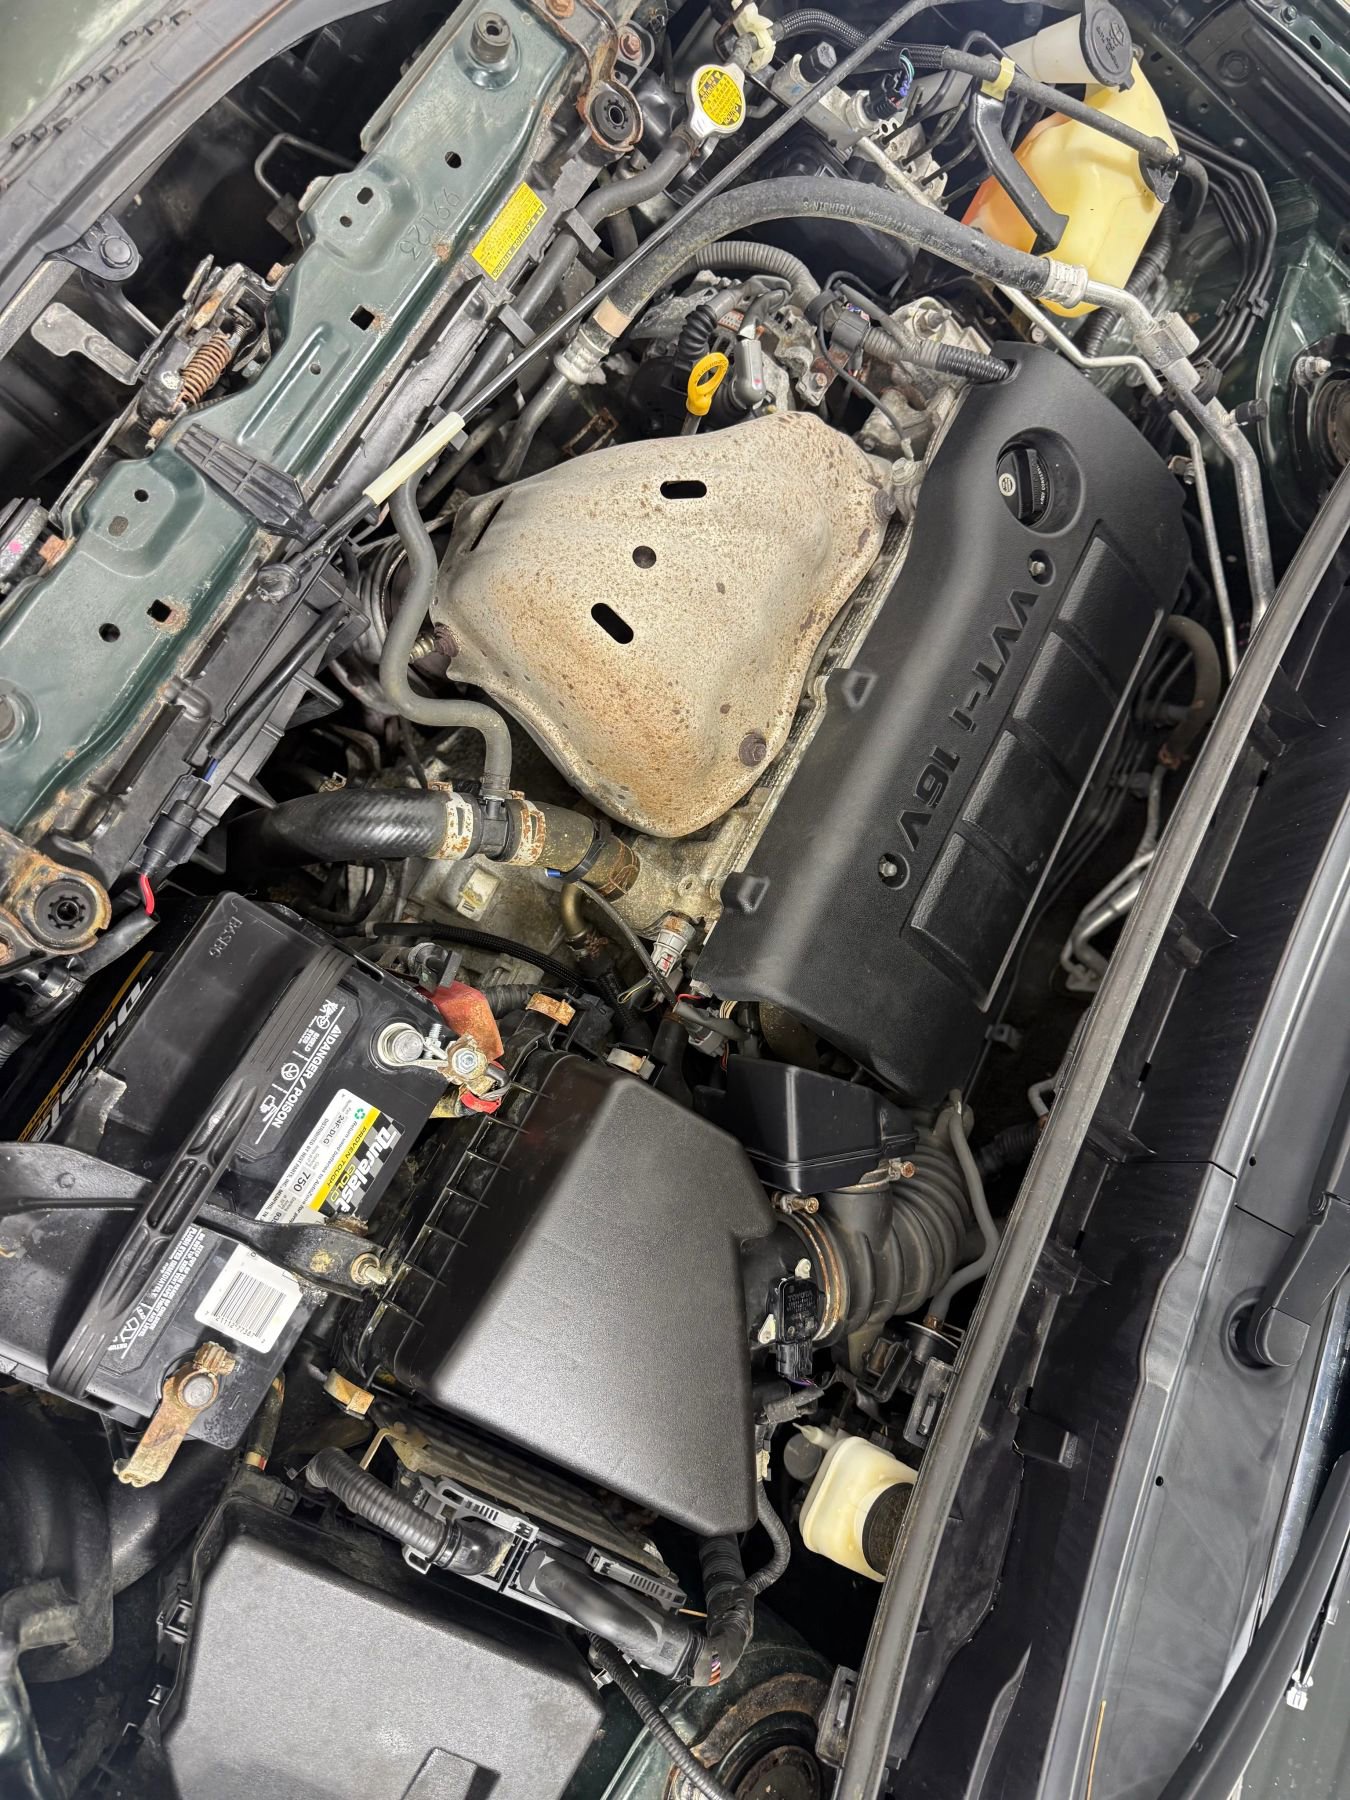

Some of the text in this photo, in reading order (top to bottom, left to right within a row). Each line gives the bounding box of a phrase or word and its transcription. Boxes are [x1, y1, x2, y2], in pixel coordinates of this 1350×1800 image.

[896, 589, 1039, 852] VVT-i 16V
[321, 1113, 345, 1145] 24F-DLG
[325, 1125, 366, 1187] PROVEN TOUGH
[334, 1126, 397, 1214] Duralast
[291, 1169, 311, 1193] 750
[328, 1162, 356, 1202] GOLD
[173, 1245, 186, 1261] EYES
[182, 1227, 197, 1247] FLUSH
